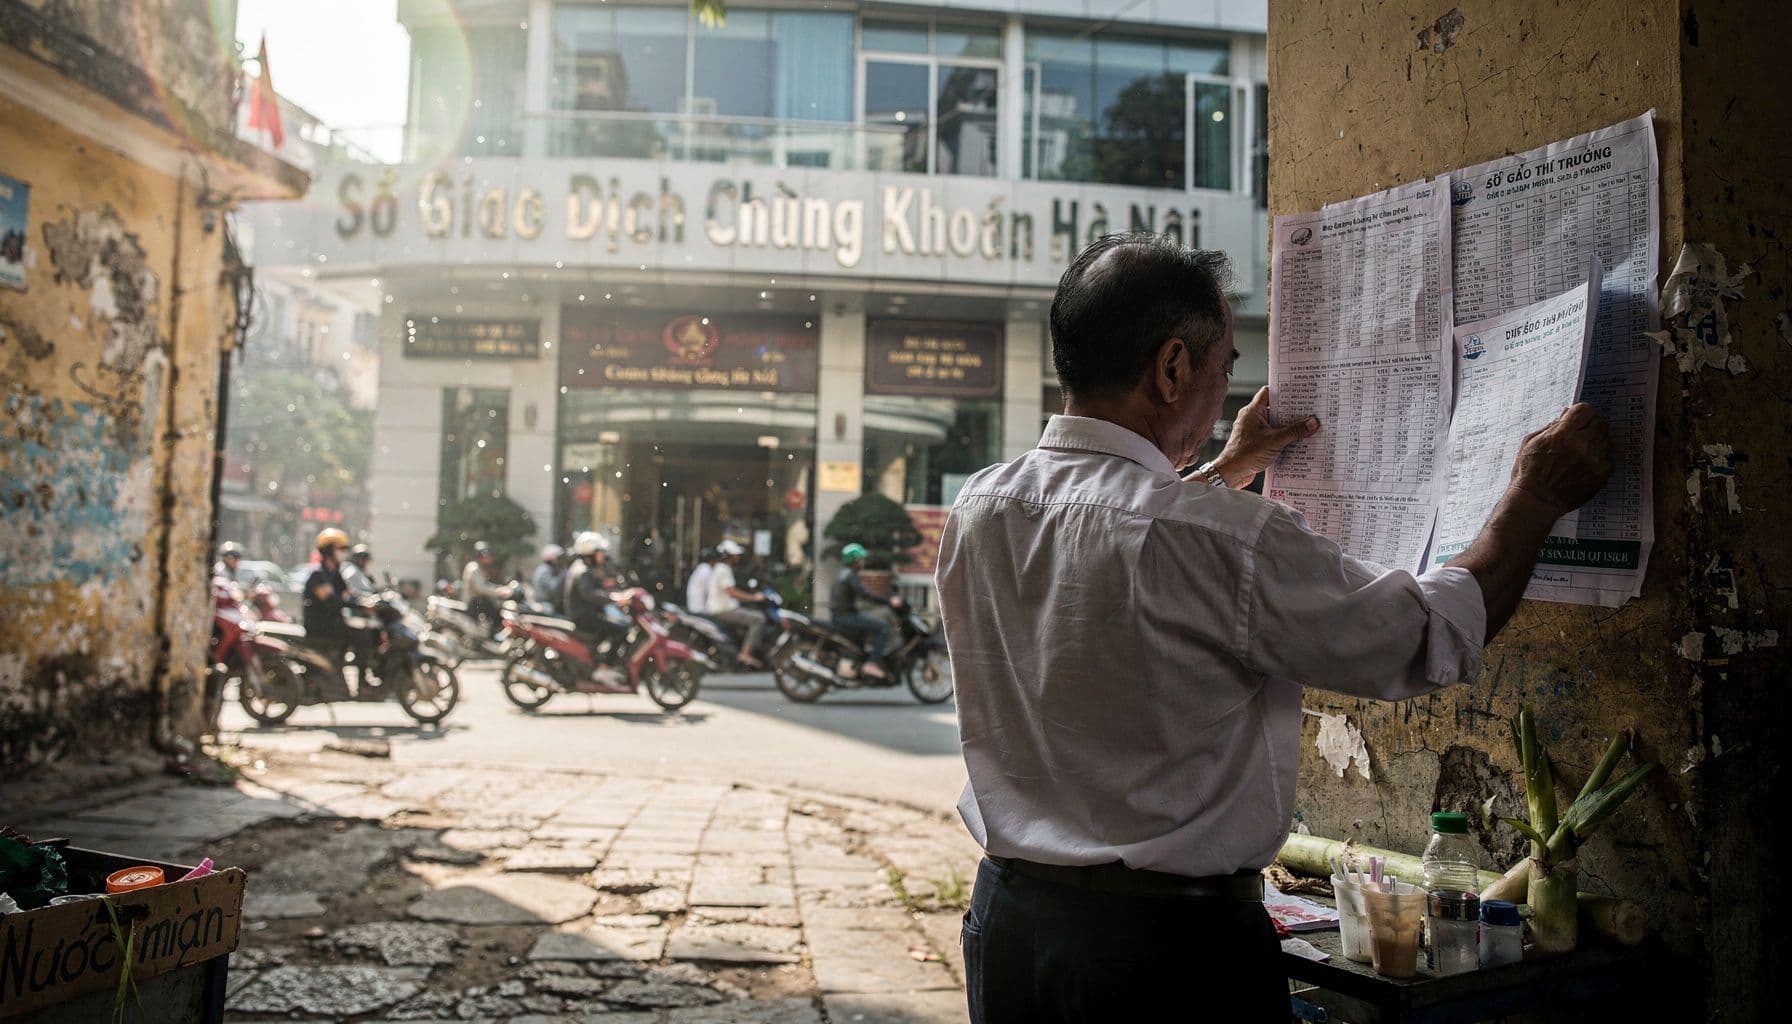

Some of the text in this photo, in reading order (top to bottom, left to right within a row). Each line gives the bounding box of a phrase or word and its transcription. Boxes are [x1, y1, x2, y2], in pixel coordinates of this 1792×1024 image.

[418, 169, 545, 240] Giao
[565, 173, 686, 254] Dịch
[880, 185, 1034, 262] Khoán
